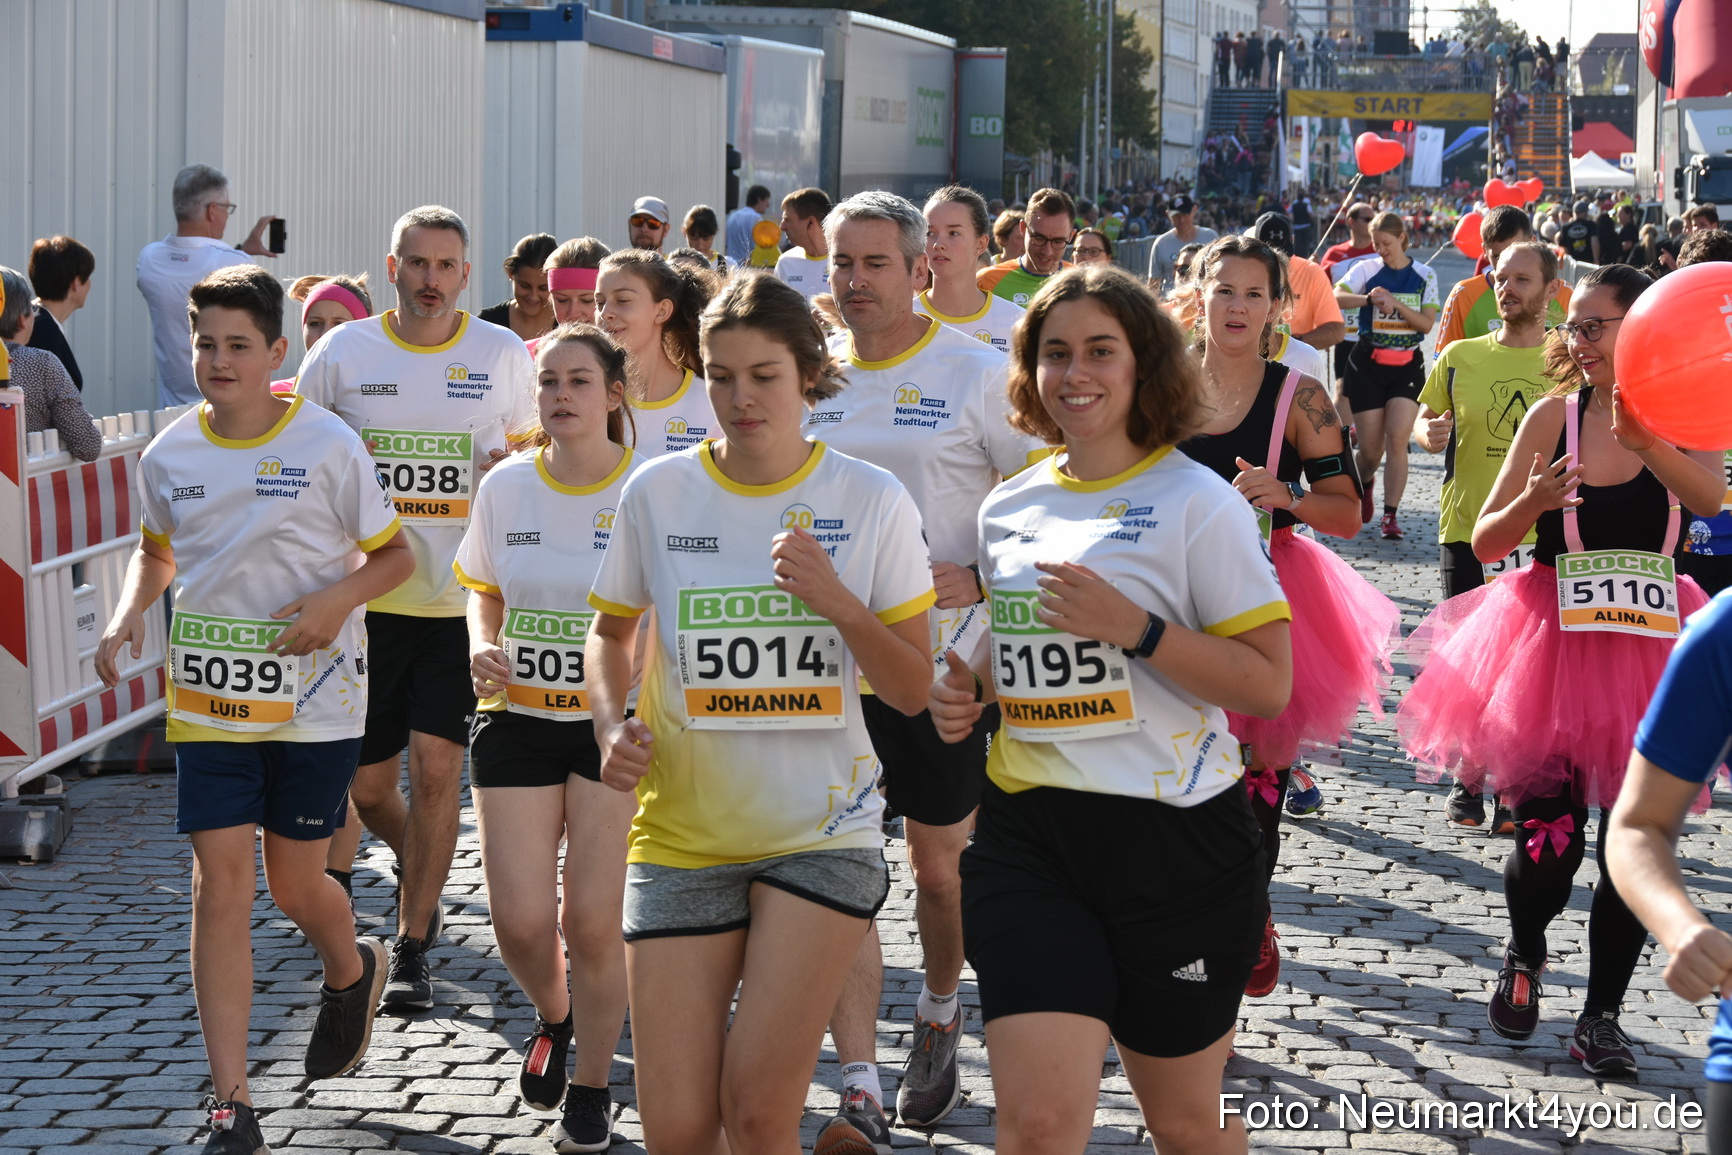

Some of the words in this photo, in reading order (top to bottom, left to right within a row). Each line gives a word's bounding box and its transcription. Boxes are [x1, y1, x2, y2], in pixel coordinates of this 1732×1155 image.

[1354, 97, 1424, 113] START
[448, 368, 467, 380] 20
[361, 384, 398, 392] BOCK
[447, 382, 493, 391] Neumarkter
[447, 391, 484, 401] Stadtlauf
[897, 388, 920, 404] 20
[895, 406, 951, 419] Neumarkter
[668, 421, 686, 434] 20
[894, 417, 938, 429] Stadtlauf
[371, 434, 463, 456] BOCK
[258, 461, 281, 476] 20
[256, 477, 311, 488] Neumarkter
[376, 462, 460, 494] 5038
[172, 486, 205, 498] BOCK
[256, 488, 299, 500] Stadtlauf
[393, 501, 450, 514] ARKUS
[1101, 503, 1128, 519] 20
[785, 510, 813, 528] 20
[815, 520, 841, 528] JAHRE
[507, 532, 540, 542] BOCK
[667, 535, 719, 548] BOCK
[1569, 554, 1666, 578] BOCK
[1573, 579, 1665, 609] 5110
[950, 608, 975, 645] September
[1594, 611, 1648, 626] ALINA
[181, 622, 283, 648] BOCK
[516, 646, 585, 683] 503
[697, 635, 825, 680] 5014
[828, 638, 836, 647] S
[1000, 640, 1107, 688] 5195
[183, 653, 282, 693] 5039
[304, 664, 336, 699] September
[545, 693, 581, 708] LEA
[705, 693, 822, 712] JOHANNA
[210, 700, 250, 718] LUIS
[1005, 698, 1116, 722] KATHARINA
[1199, 732, 1217, 755] 2019
[306, 818, 324, 826] JAKO
[1172, 969, 1208, 982] adidas
